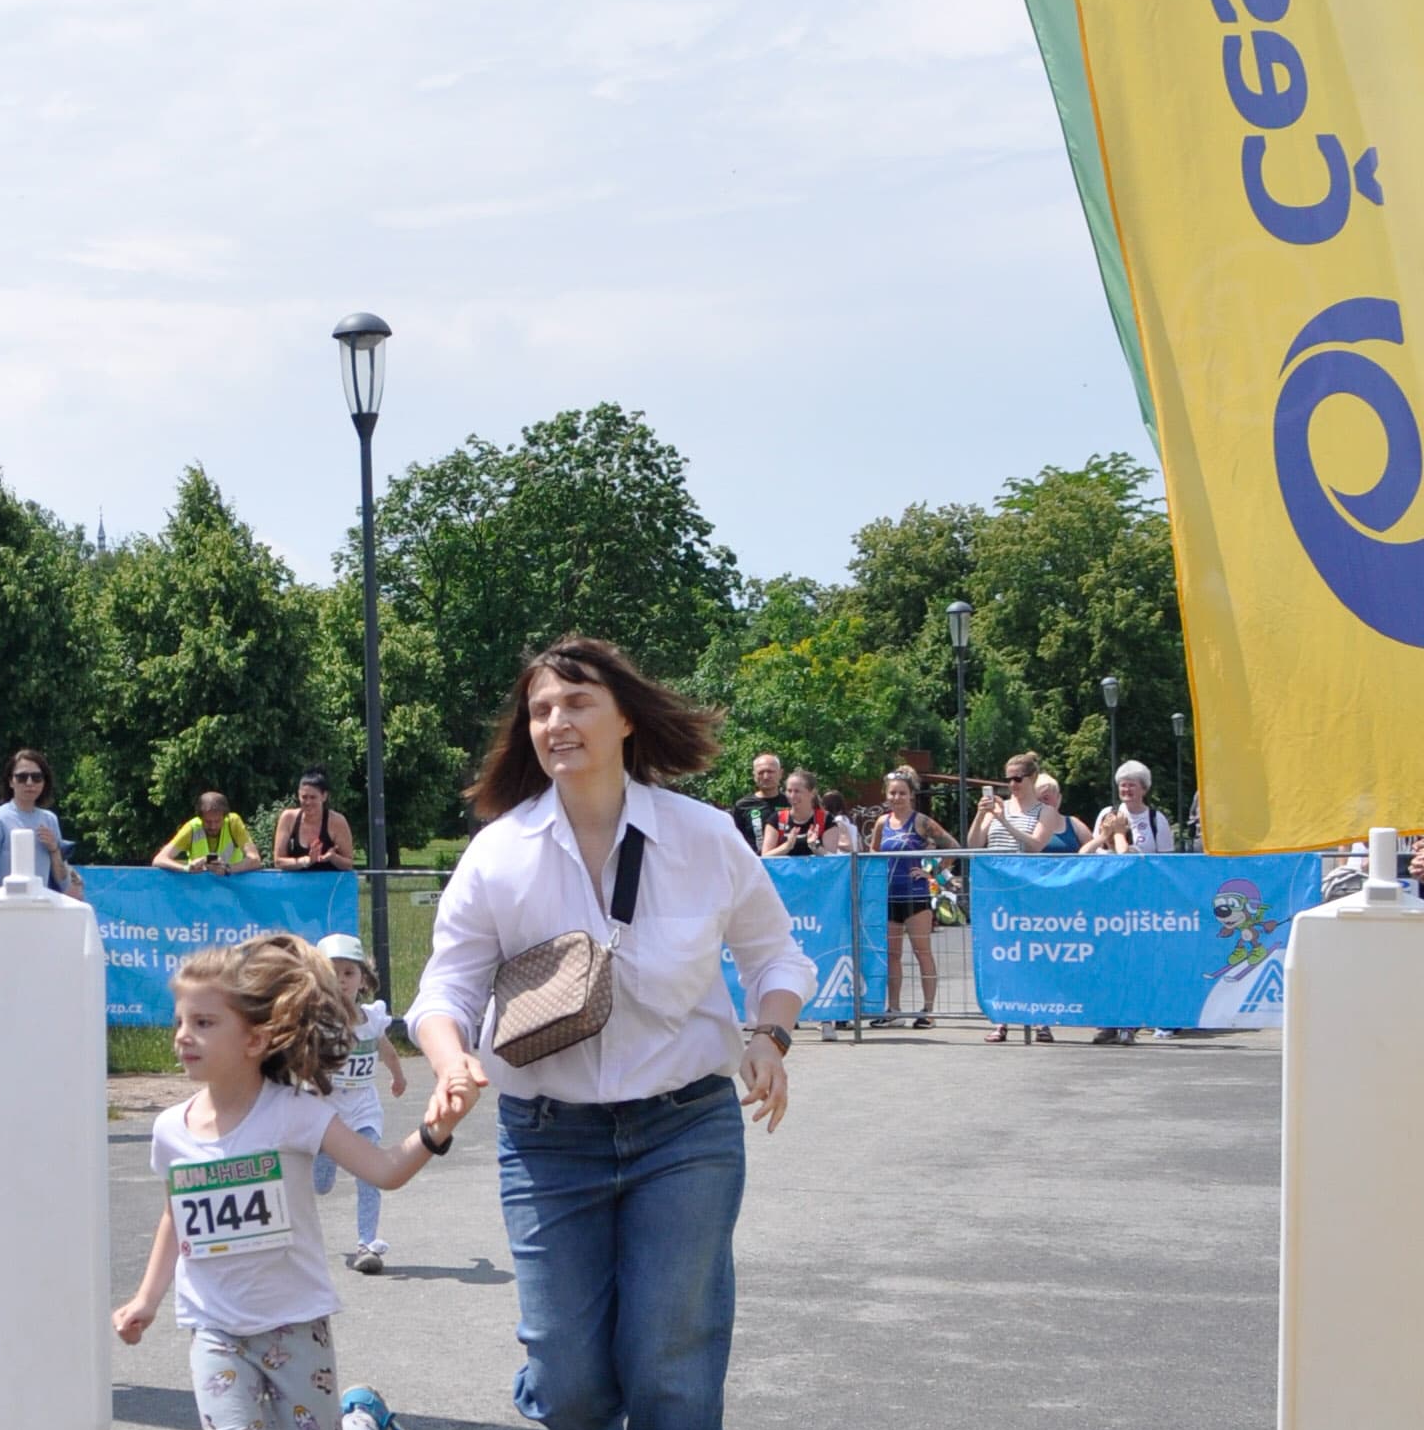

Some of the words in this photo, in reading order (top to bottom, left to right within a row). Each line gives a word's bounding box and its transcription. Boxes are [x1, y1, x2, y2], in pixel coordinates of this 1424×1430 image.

[99, 920, 159, 941] stíme
[165, 923, 209, 942] vaši
[991, 906, 1087, 932] Úrazové
[1094, 910, 1200, 937] pojištění
[991, 942, 1022, 962] od
[1029, 943, 1095, 962] PVZP
[991, 1002, 1084, 1015] www.pvzp.cz
[218, 1156, 275, 1183] HELP
[181, 1189, 273, 1236] 2144
